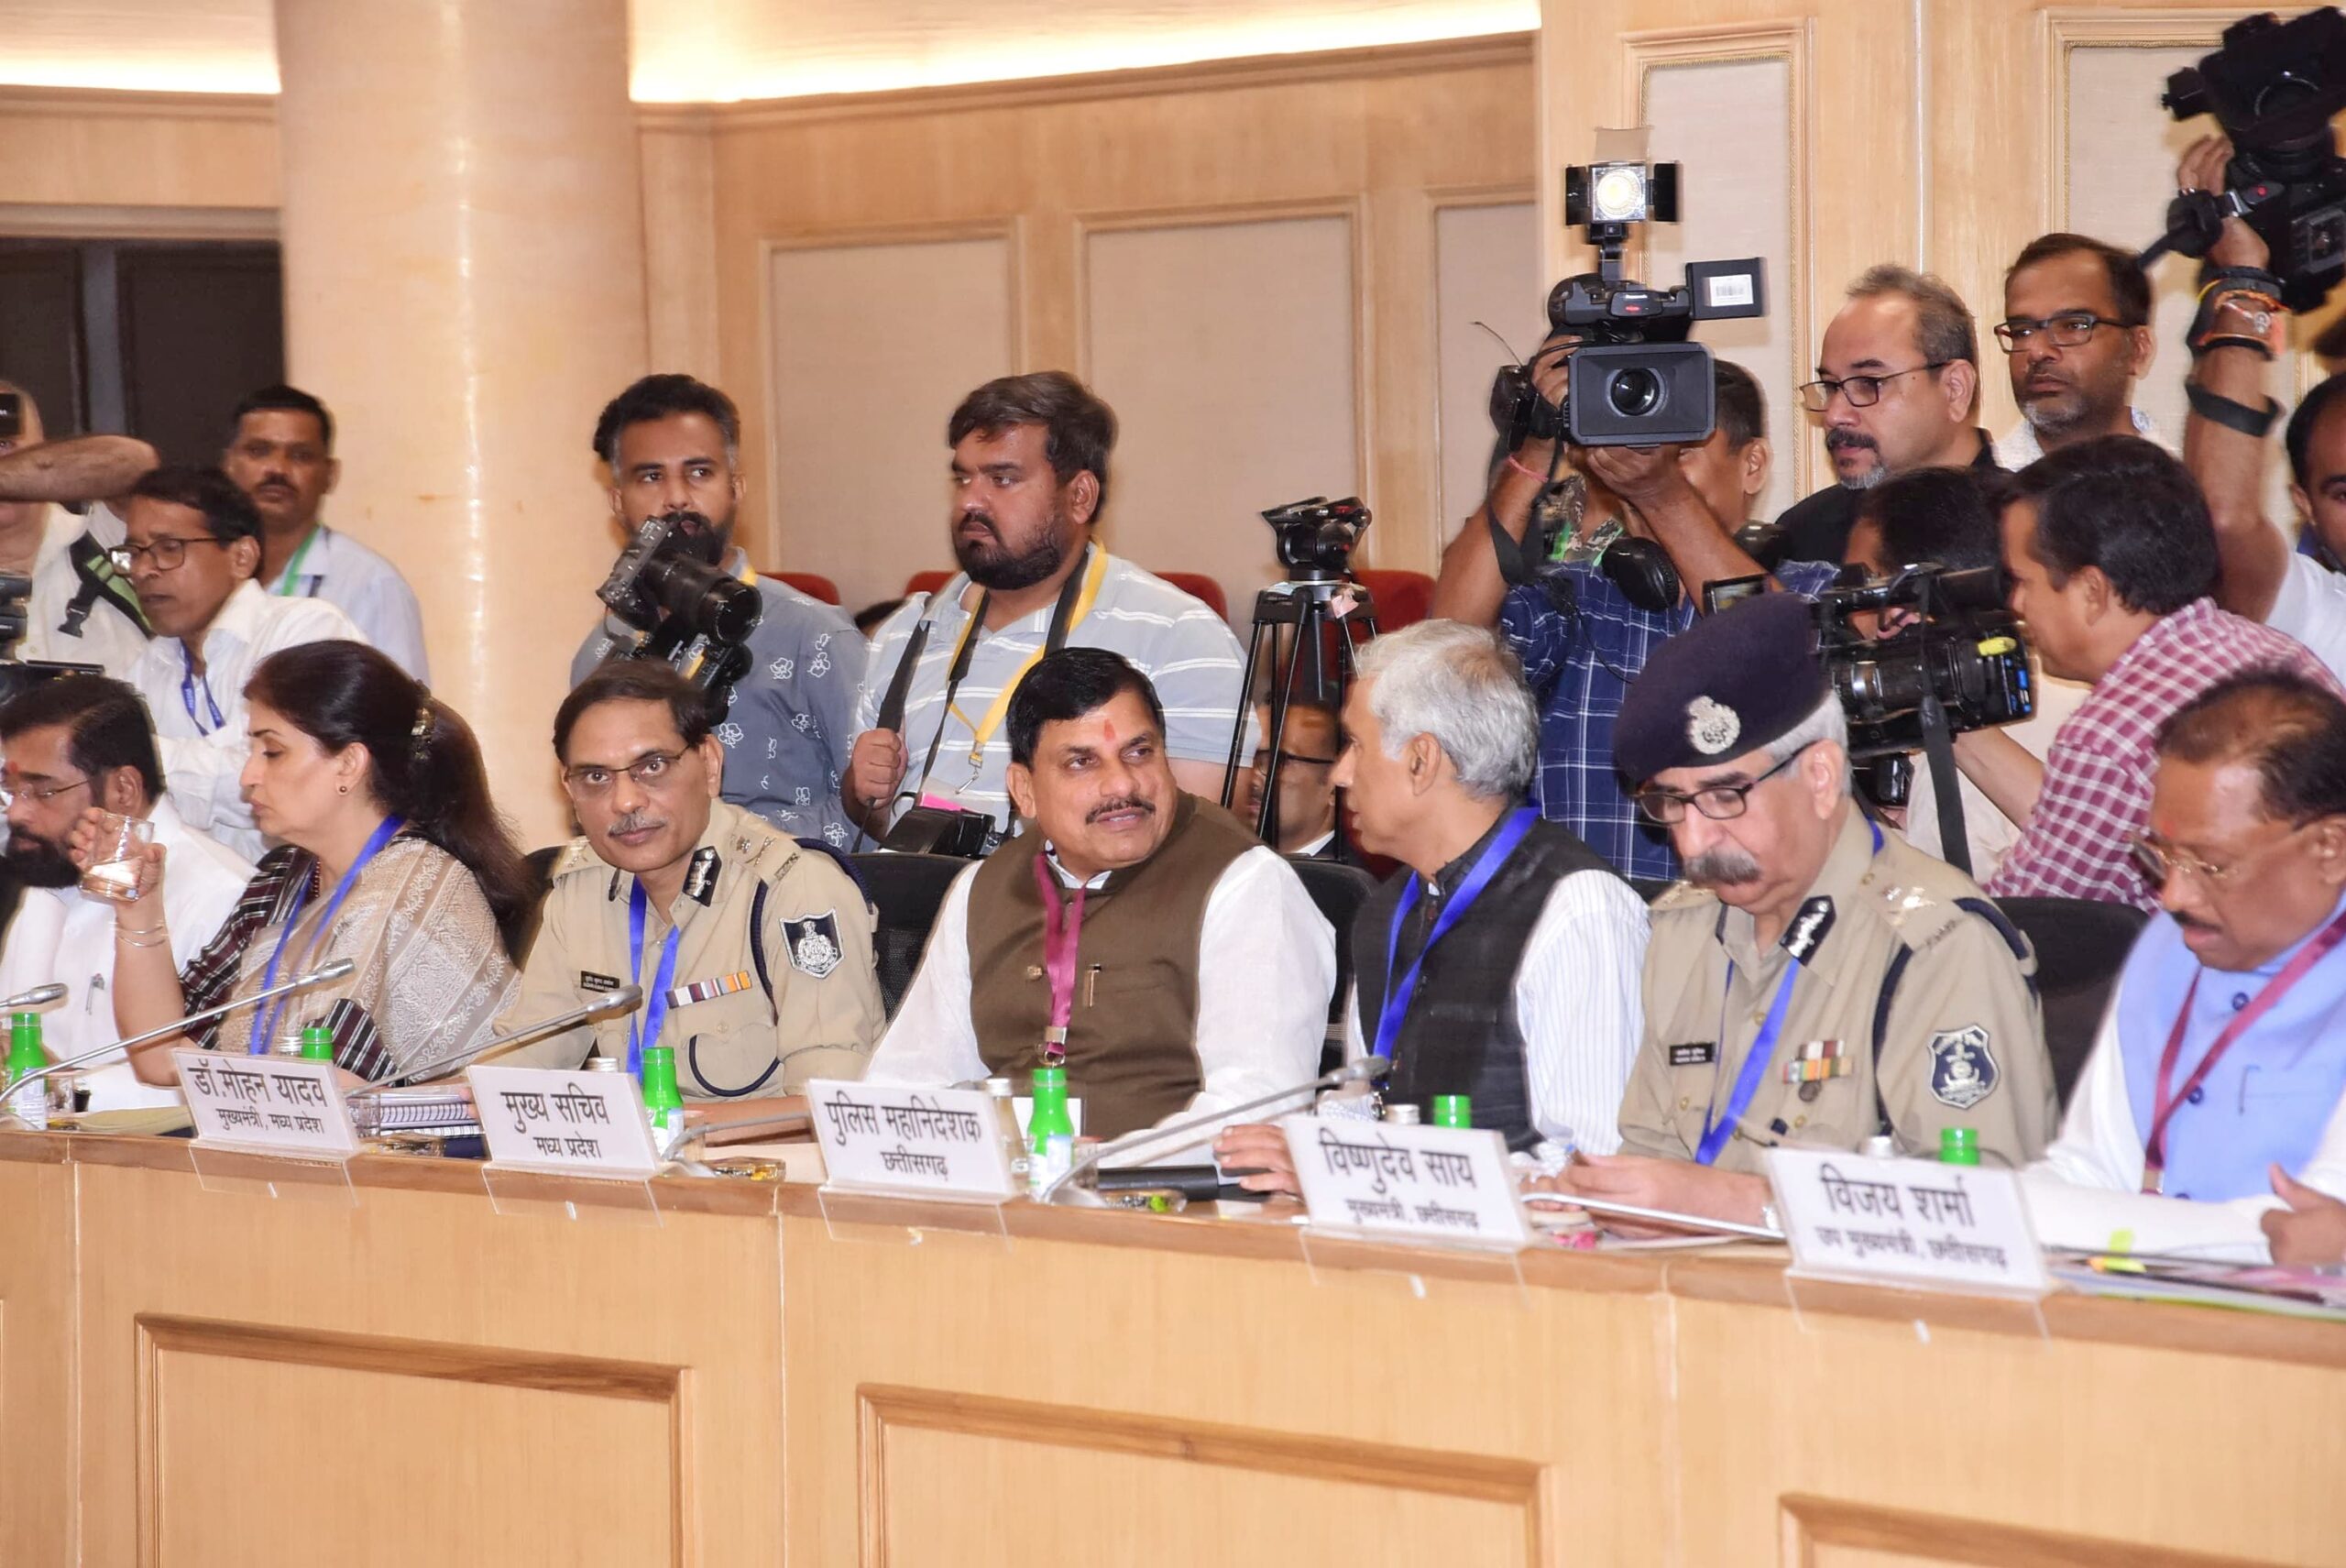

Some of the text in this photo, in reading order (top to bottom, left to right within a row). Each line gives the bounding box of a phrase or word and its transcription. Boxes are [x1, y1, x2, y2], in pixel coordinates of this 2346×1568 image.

[270, 1074, 328, 1107] यादव
[499, 1081, 610, 1134] मुख्य सचिव
[215, 1105, 269, 1131] मुख्यमंत्री,
[293, 1111, 324, 1134] प्रदेश
[825, 1091, 981, 1146] पुलिस महानिदेशक
[532, 1130, 602, 1158] मध्य प्रदेश
[880, 1144, 948, 1181] छत्तीसगढ़
[1320, 1127, 1477, 1194] विष्णुदेव साय
[1819, 1162, 1976, 1227] विजय शर्मा
